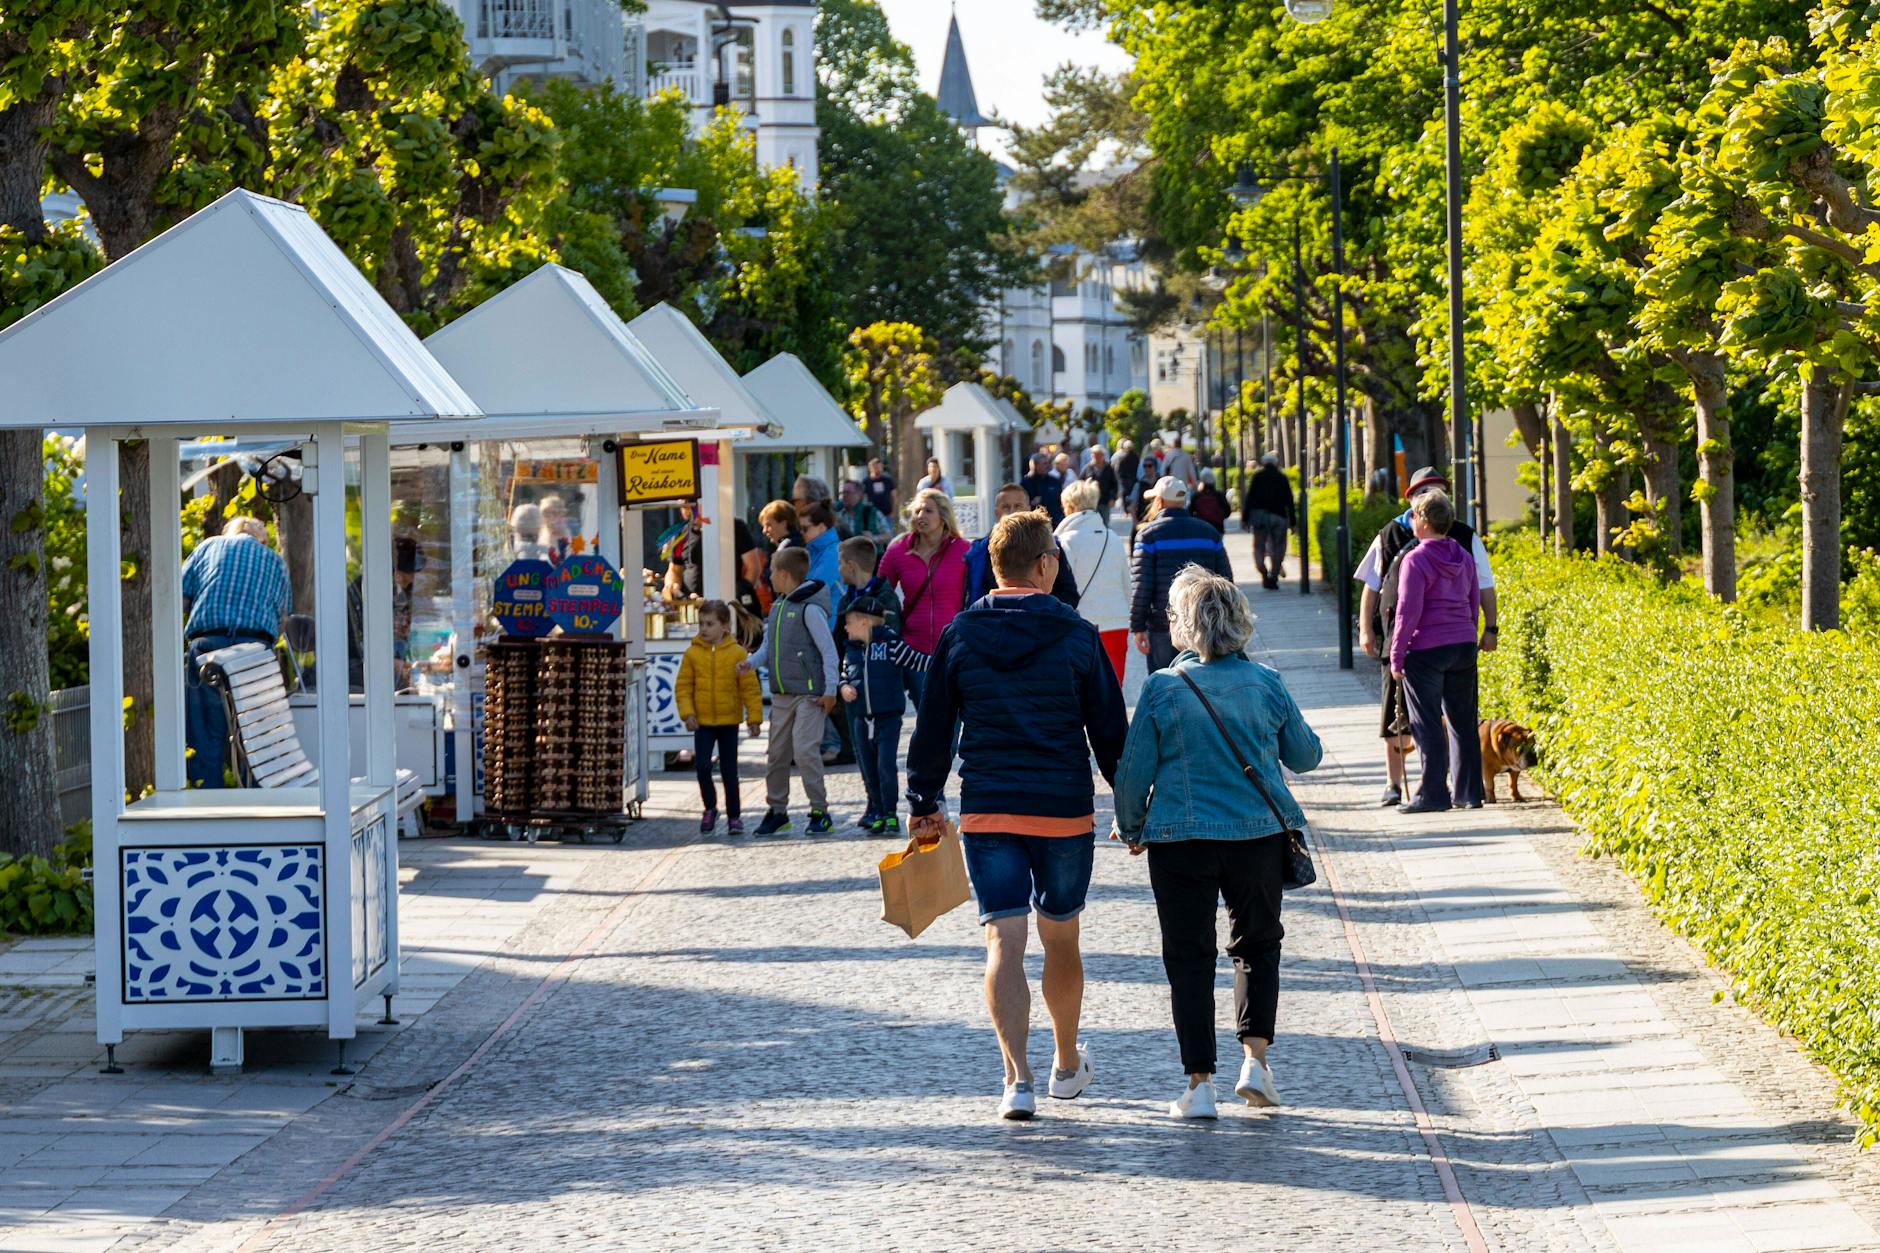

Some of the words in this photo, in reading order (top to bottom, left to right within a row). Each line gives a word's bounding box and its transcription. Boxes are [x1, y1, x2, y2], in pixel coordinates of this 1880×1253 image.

[643, 447, 687, 464] Name
[625, 475, 694, 495] Reiskorn
[549, 598, 620, 615] STEMPEL
[870, 642, 887, 660] M
